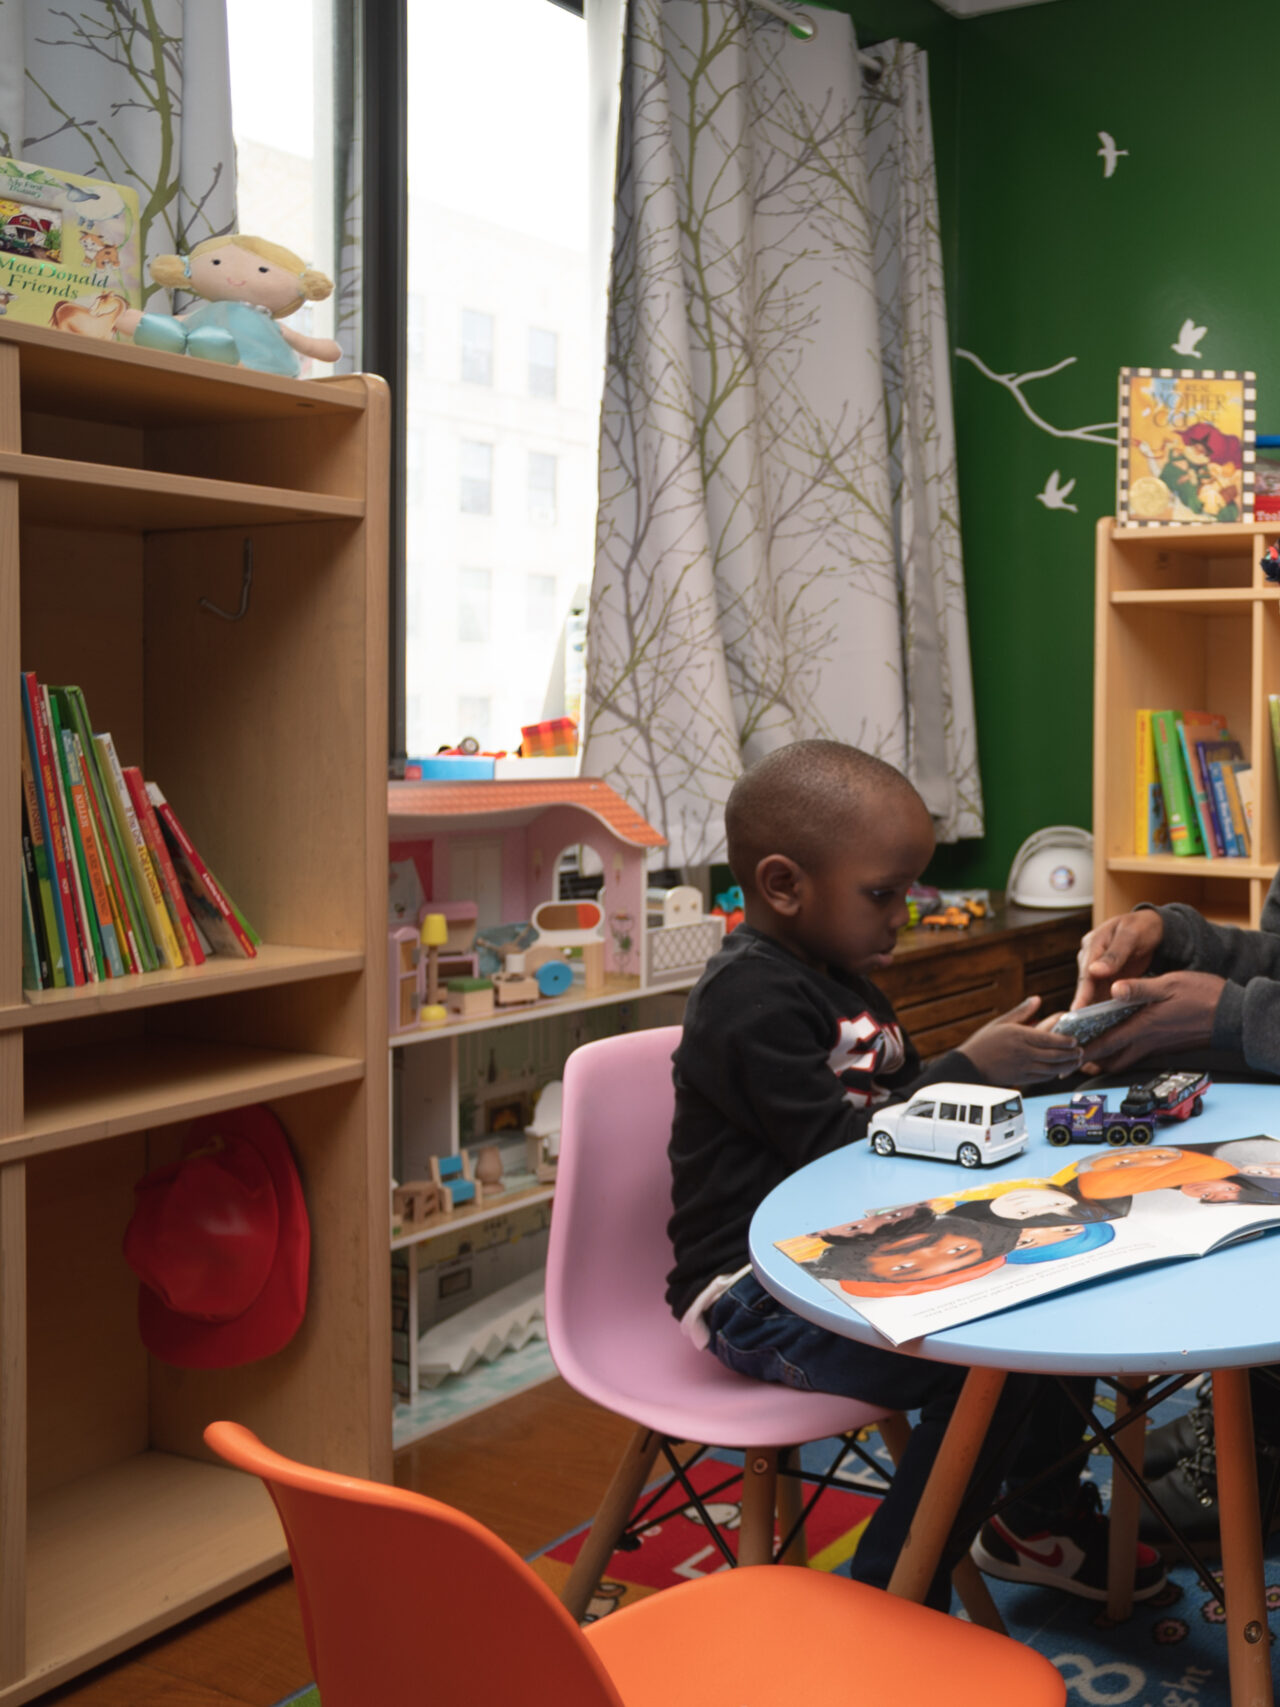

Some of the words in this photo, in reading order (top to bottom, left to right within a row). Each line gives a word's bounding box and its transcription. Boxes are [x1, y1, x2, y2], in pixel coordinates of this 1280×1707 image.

[0, 256, 109, 289] MacDonald
[8, 273, 79, 299] Friends
[25, 780, 37, 808] FAMILY
[73, 793, 89, 828] KELLER
[29, 808, 43, 842] FOREVER
